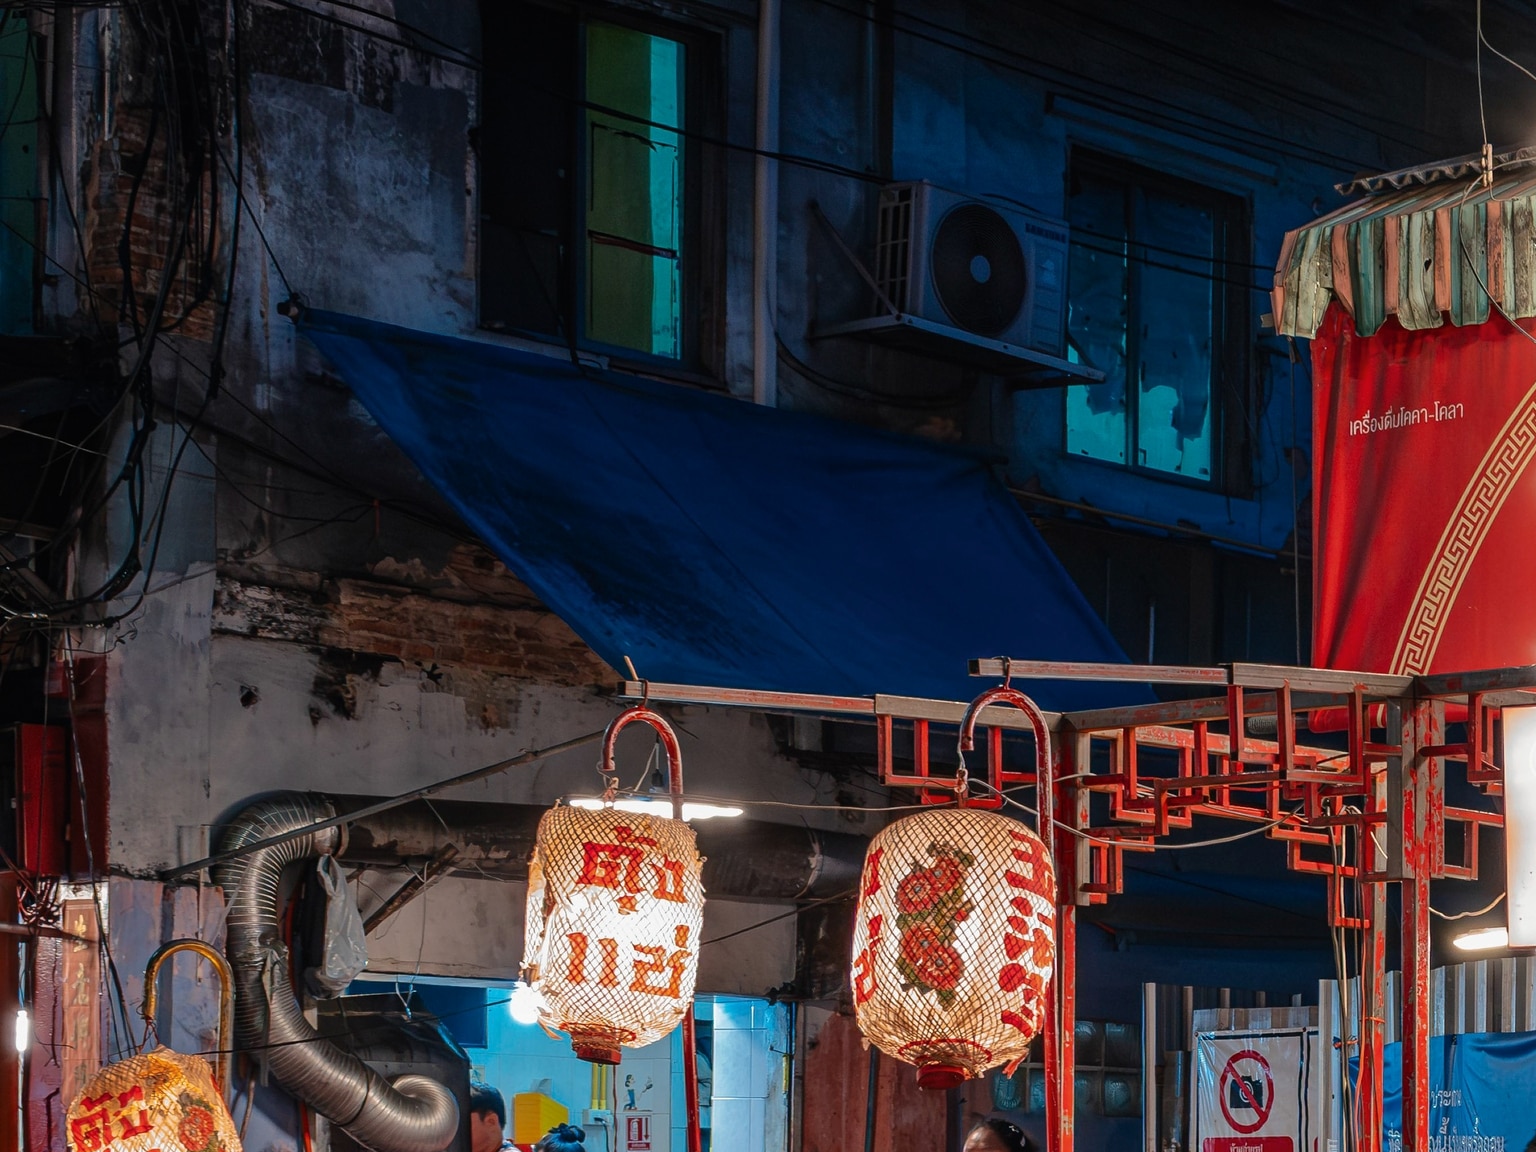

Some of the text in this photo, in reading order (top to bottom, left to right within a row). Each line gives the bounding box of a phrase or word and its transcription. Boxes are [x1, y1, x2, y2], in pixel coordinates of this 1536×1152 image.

[1349, 400, 1464, 436] เครื่องดื่มโคคา-โคลา
